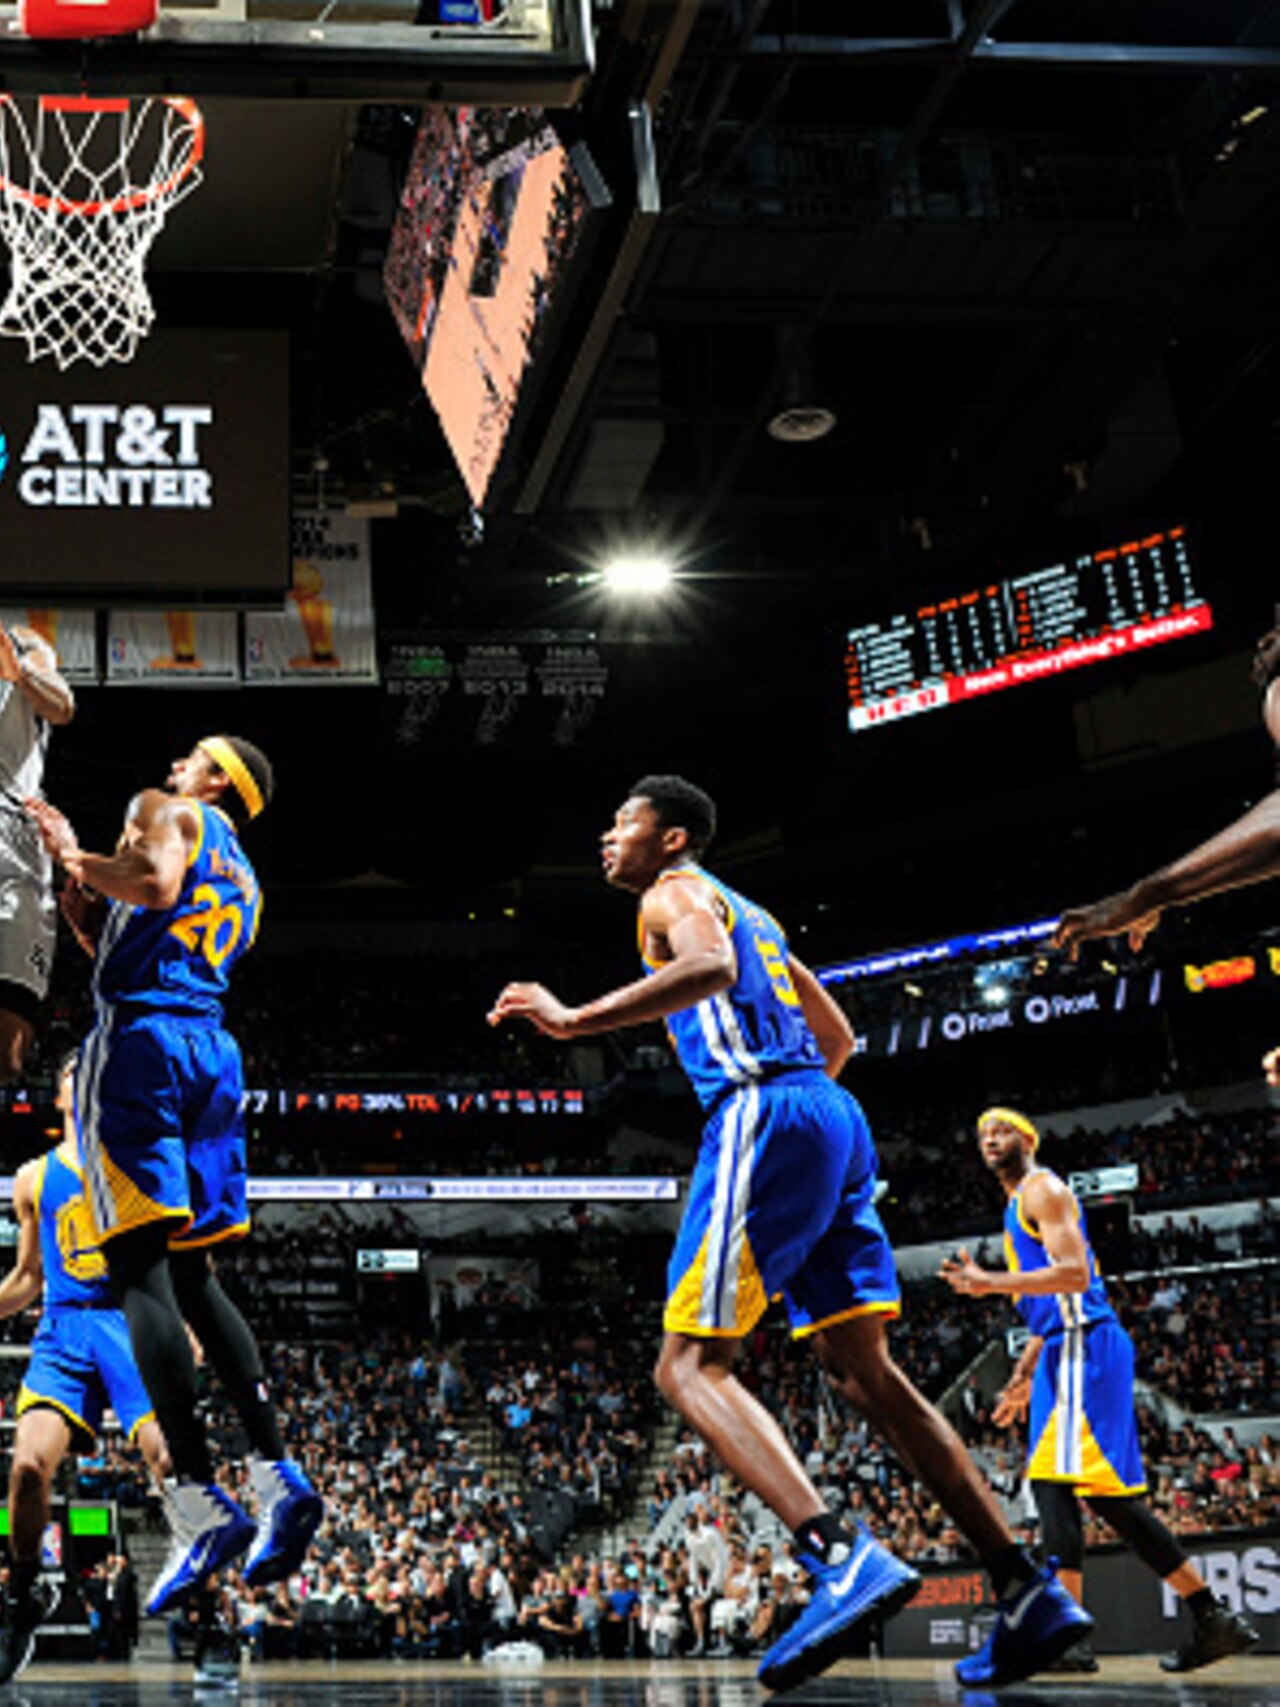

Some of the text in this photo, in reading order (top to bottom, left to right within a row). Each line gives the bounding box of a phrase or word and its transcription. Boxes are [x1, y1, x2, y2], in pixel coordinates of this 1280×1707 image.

[21, 404, 212, 464] AT&T
[19, 466, 213, 507] CENTER
[169, 883, 243, 968] 20
[752, 933, 803, 1008] 5
